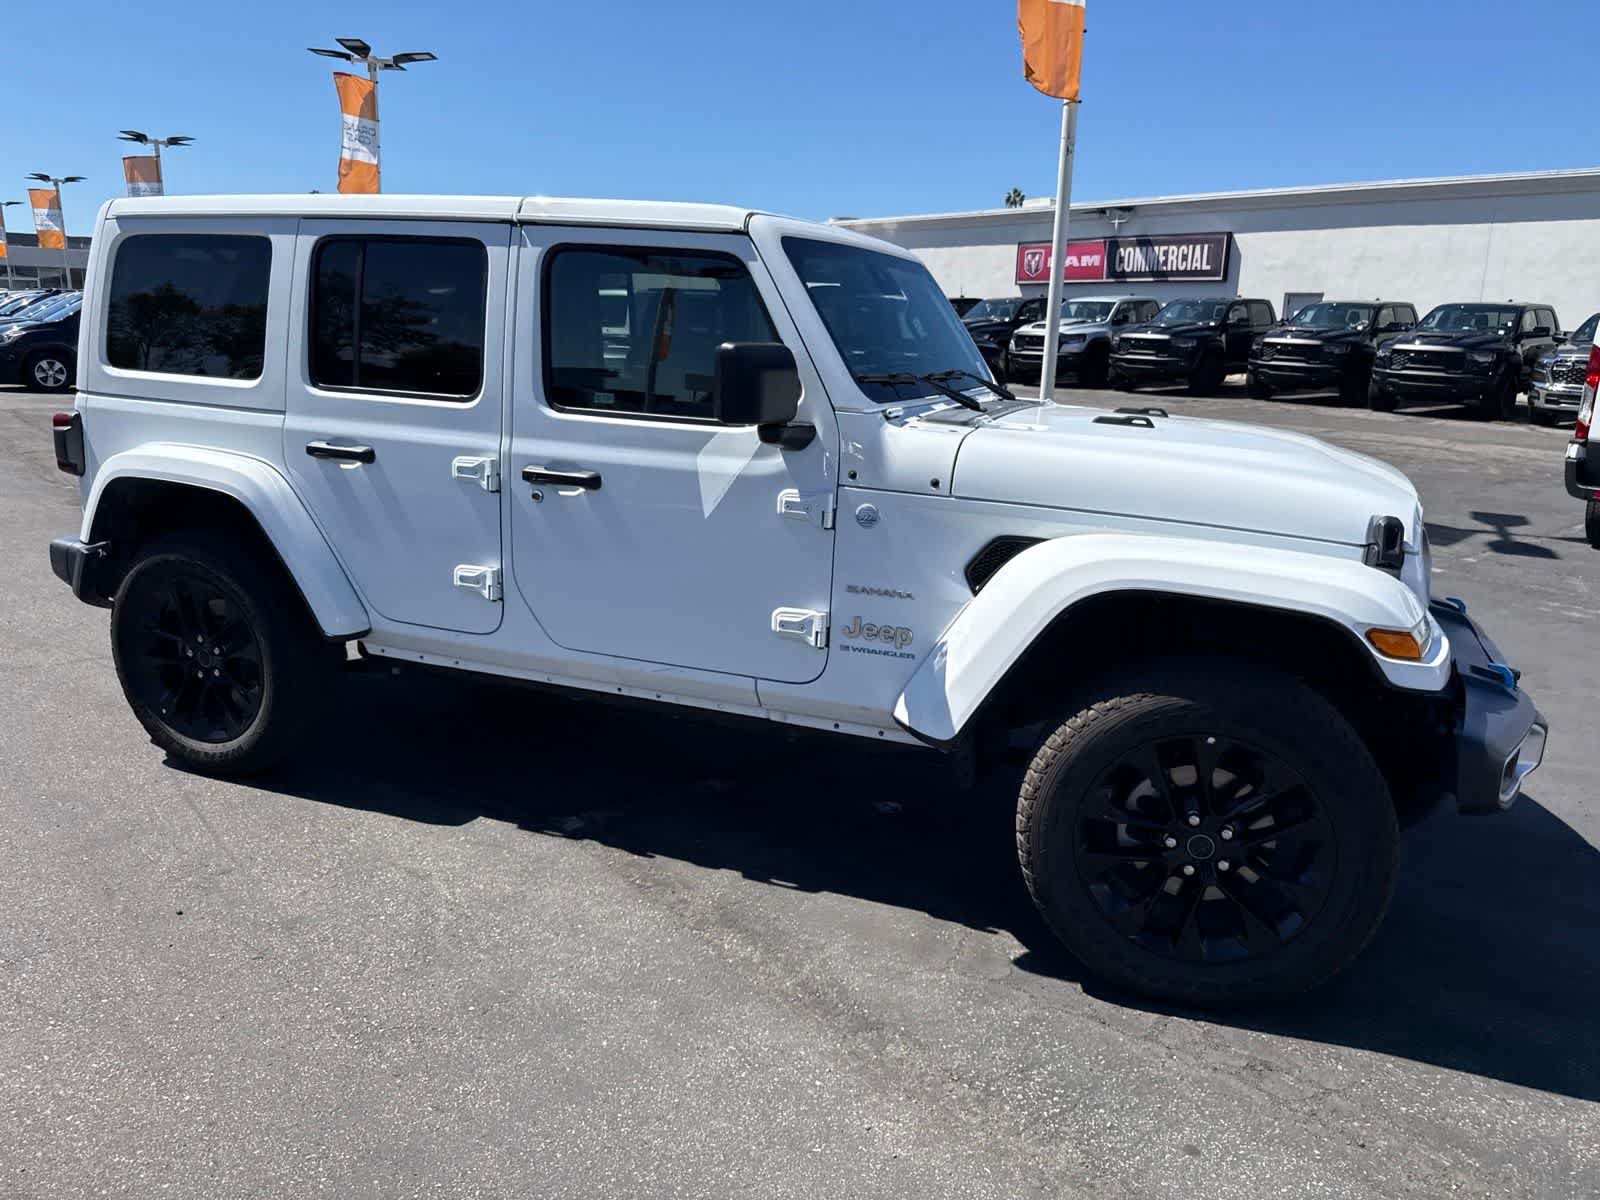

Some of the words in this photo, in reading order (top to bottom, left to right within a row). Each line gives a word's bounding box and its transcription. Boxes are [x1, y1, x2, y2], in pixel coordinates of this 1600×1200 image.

[1116, 244, 1211, 272] COMMERCIAL
[842, 615, 913, 650] Jeep
[852, 646, 915, 660] WRANGLER
